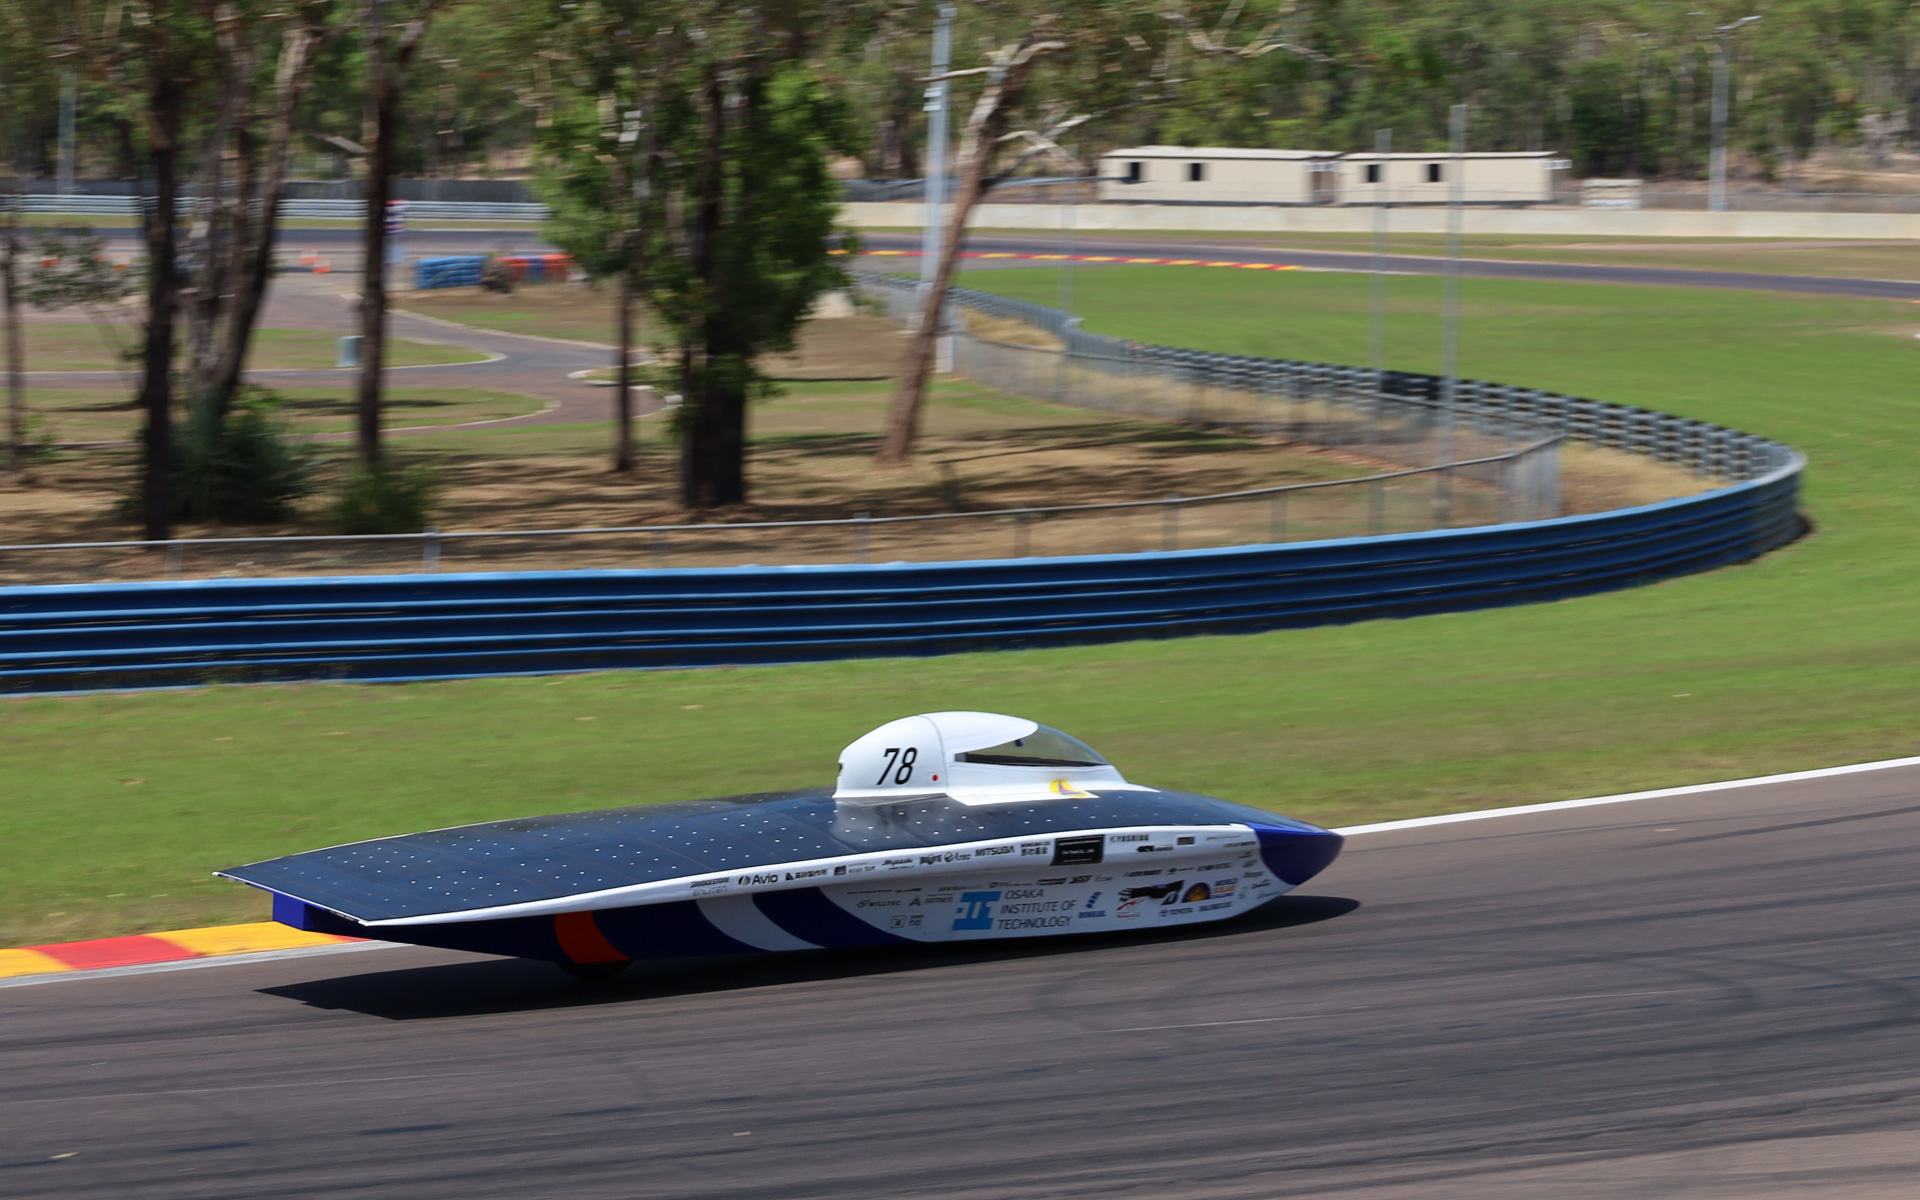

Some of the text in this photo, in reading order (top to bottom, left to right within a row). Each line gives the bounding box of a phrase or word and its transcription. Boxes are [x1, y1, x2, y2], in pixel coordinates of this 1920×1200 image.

[876, 747, 917, 785] 78
[975, 846, 1015, 856] MITSUBA
[752, 873, 778, 886] Avio
[1004, 889, 1044, 900] OSAKA
[1000, 900, 1077, 914] INSTITUTE OF
[998, 916, 1073, 930] TECHNOLOGY
